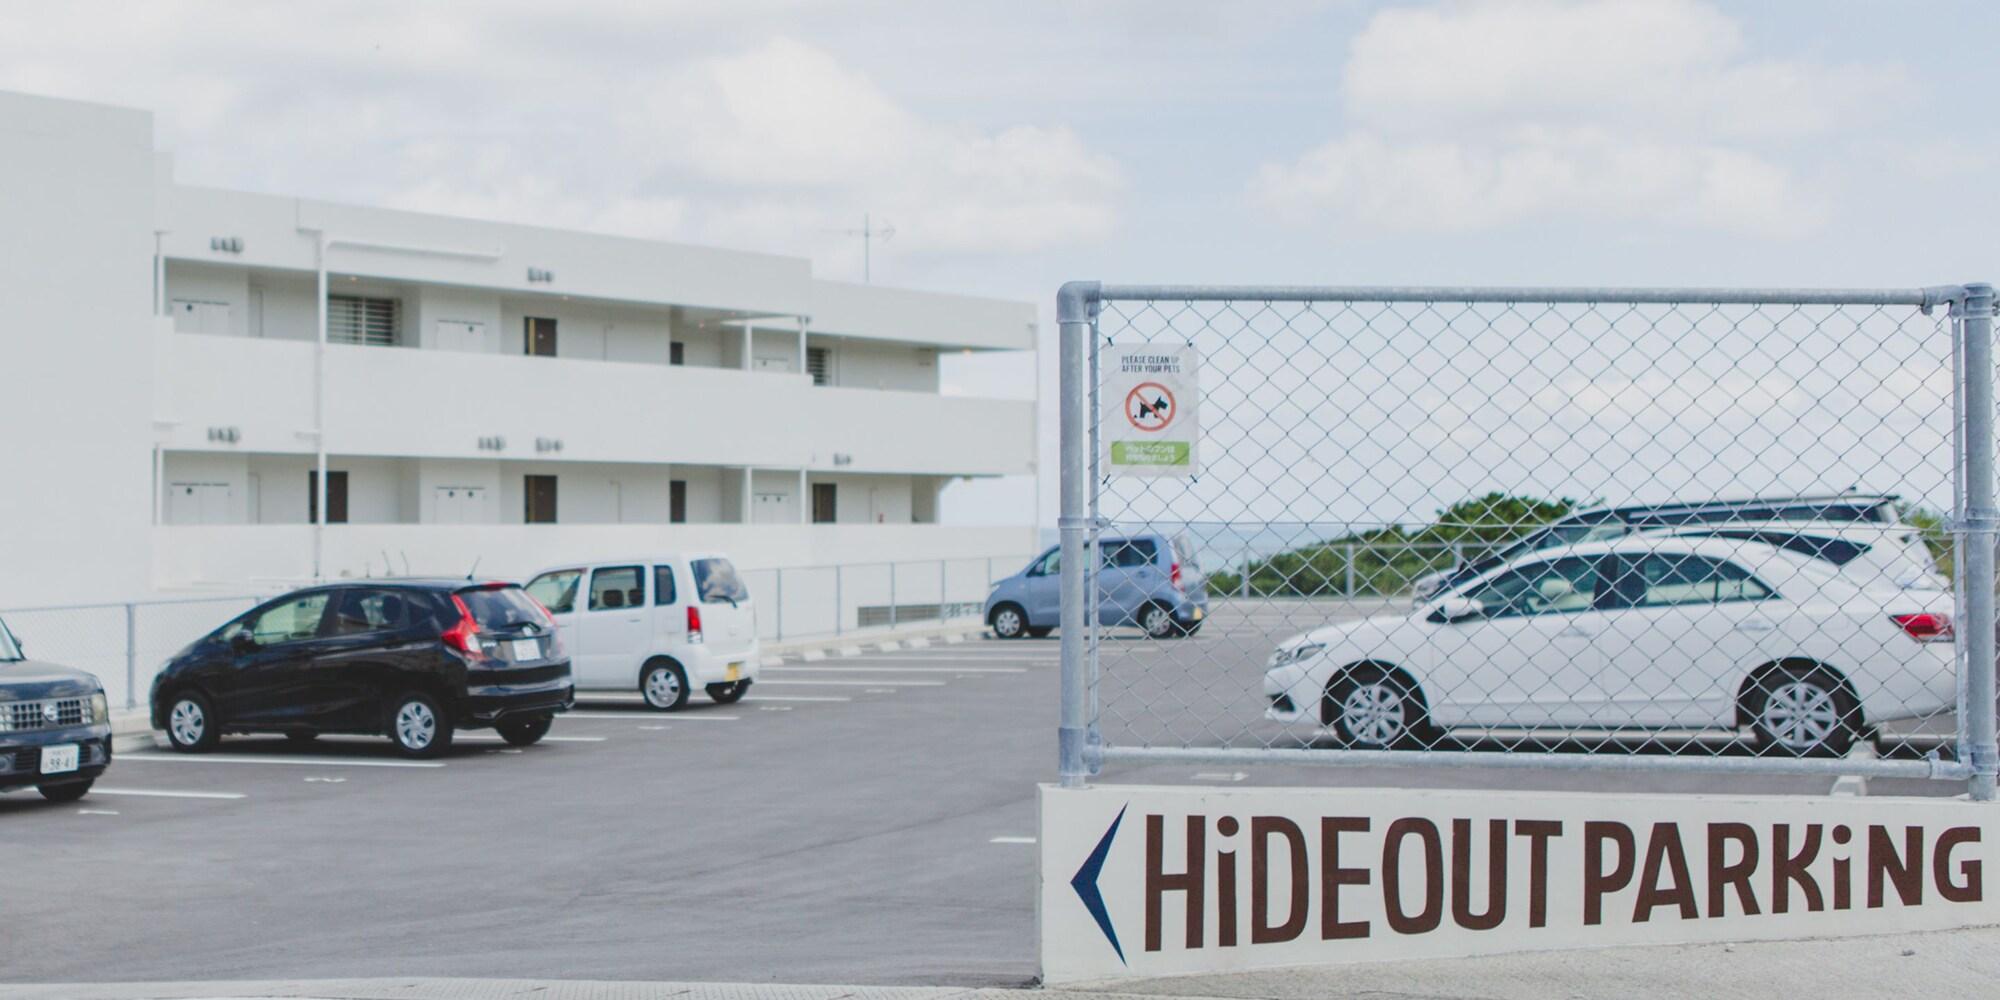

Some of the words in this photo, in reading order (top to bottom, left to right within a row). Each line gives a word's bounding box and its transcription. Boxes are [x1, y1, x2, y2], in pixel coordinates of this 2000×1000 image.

[1121, 355, 1146, 364] PLEASE
[1147, 355, 1170, 364] CLEAN
[1121, 364, 1143, 373] AFTER
[1144, 364, 1162, 373] YOUR
[1163, 364, 1181, 374] PETS
